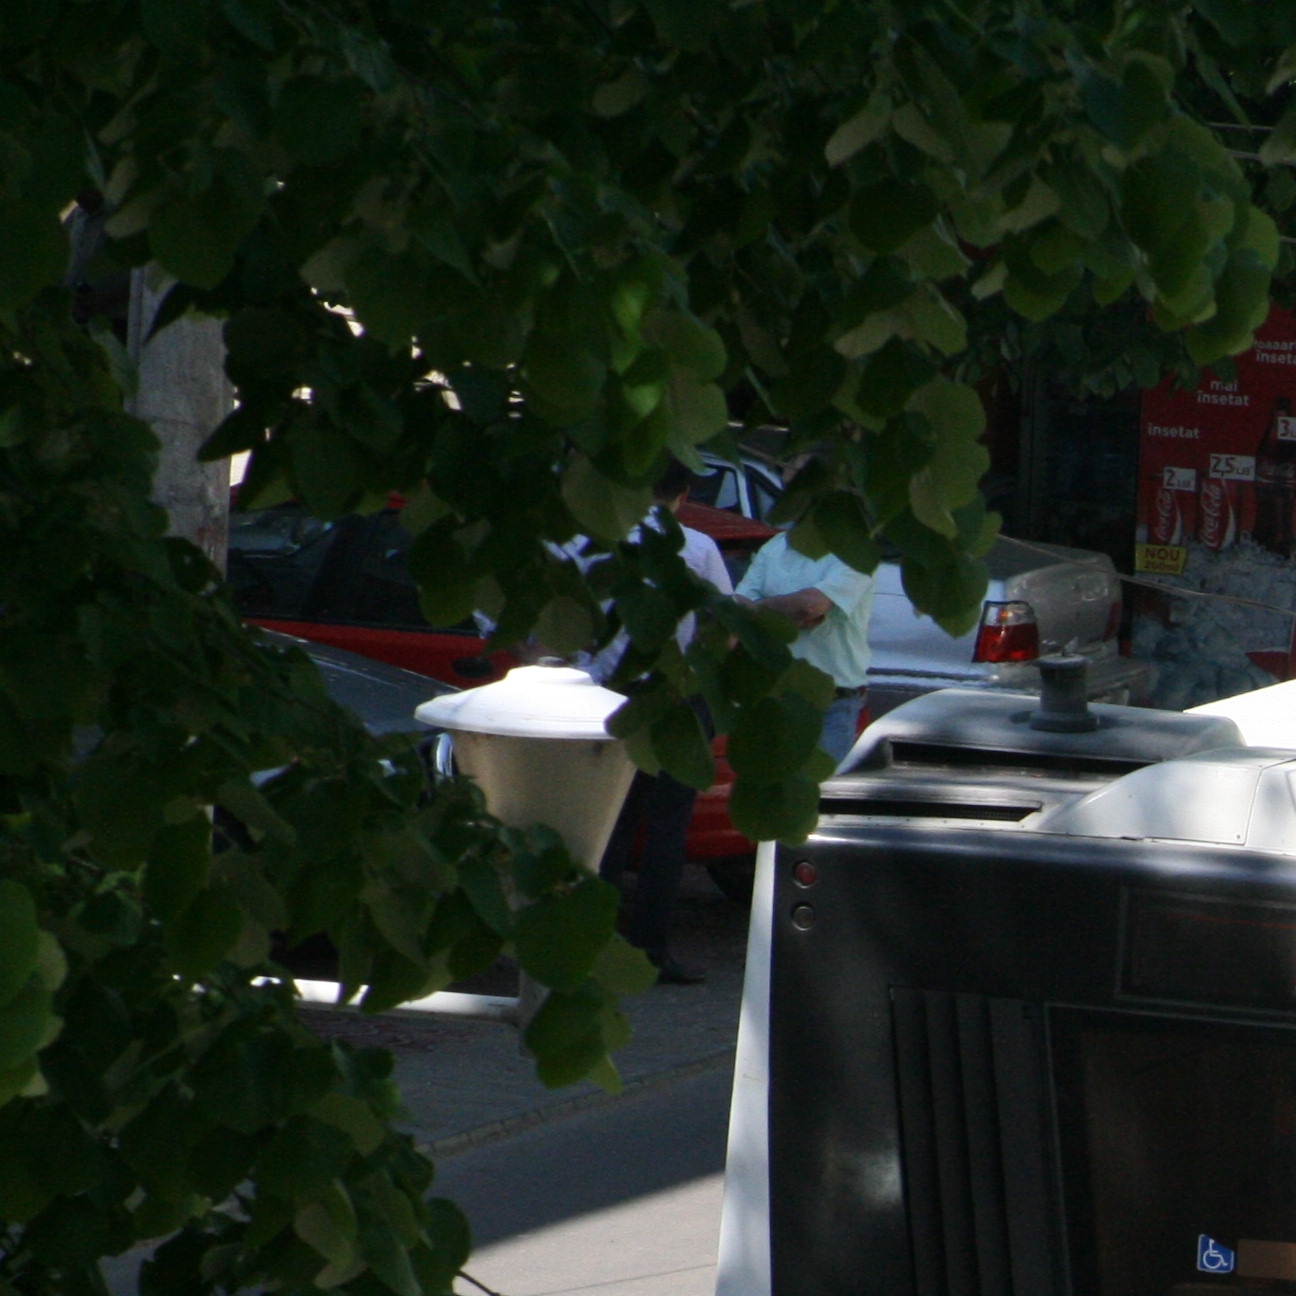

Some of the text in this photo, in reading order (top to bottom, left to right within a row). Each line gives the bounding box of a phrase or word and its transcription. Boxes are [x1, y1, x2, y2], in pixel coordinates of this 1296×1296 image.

[1196, 389, 1250, 406] însetat
[1147, 422, 1200, 440] însetat
[1279, 420, 1290, 437] 3
[1166, 469, 1176, 486] 2
[1144, 547, 1181, 561] NOU
